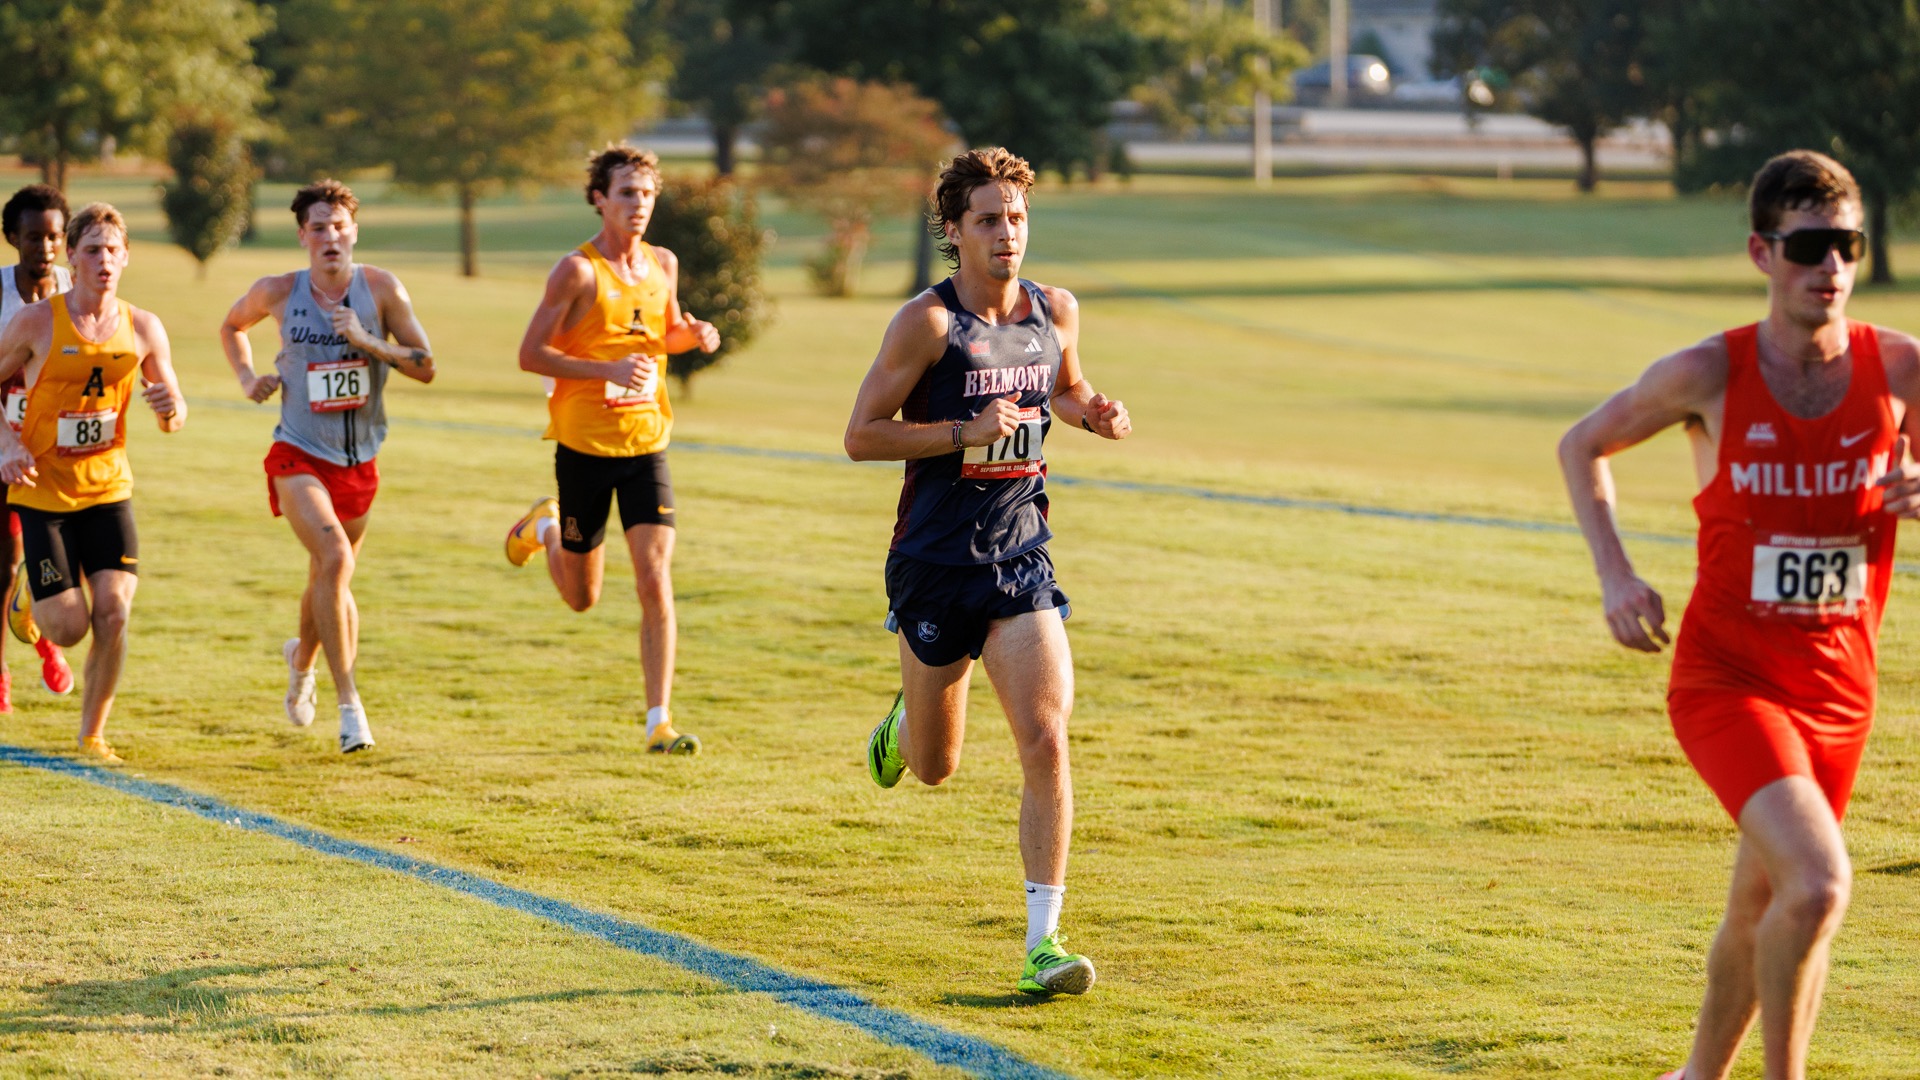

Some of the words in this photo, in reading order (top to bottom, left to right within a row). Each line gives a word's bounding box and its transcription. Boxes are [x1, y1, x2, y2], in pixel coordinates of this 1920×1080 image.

[81, 366, 105, 397] A
[322, 370, 360, 398] 126
[963, 364, 1051, 397] BELMONT
[76, 420, 102, 444] 83
[1777, 551, 1849, 601] 663
